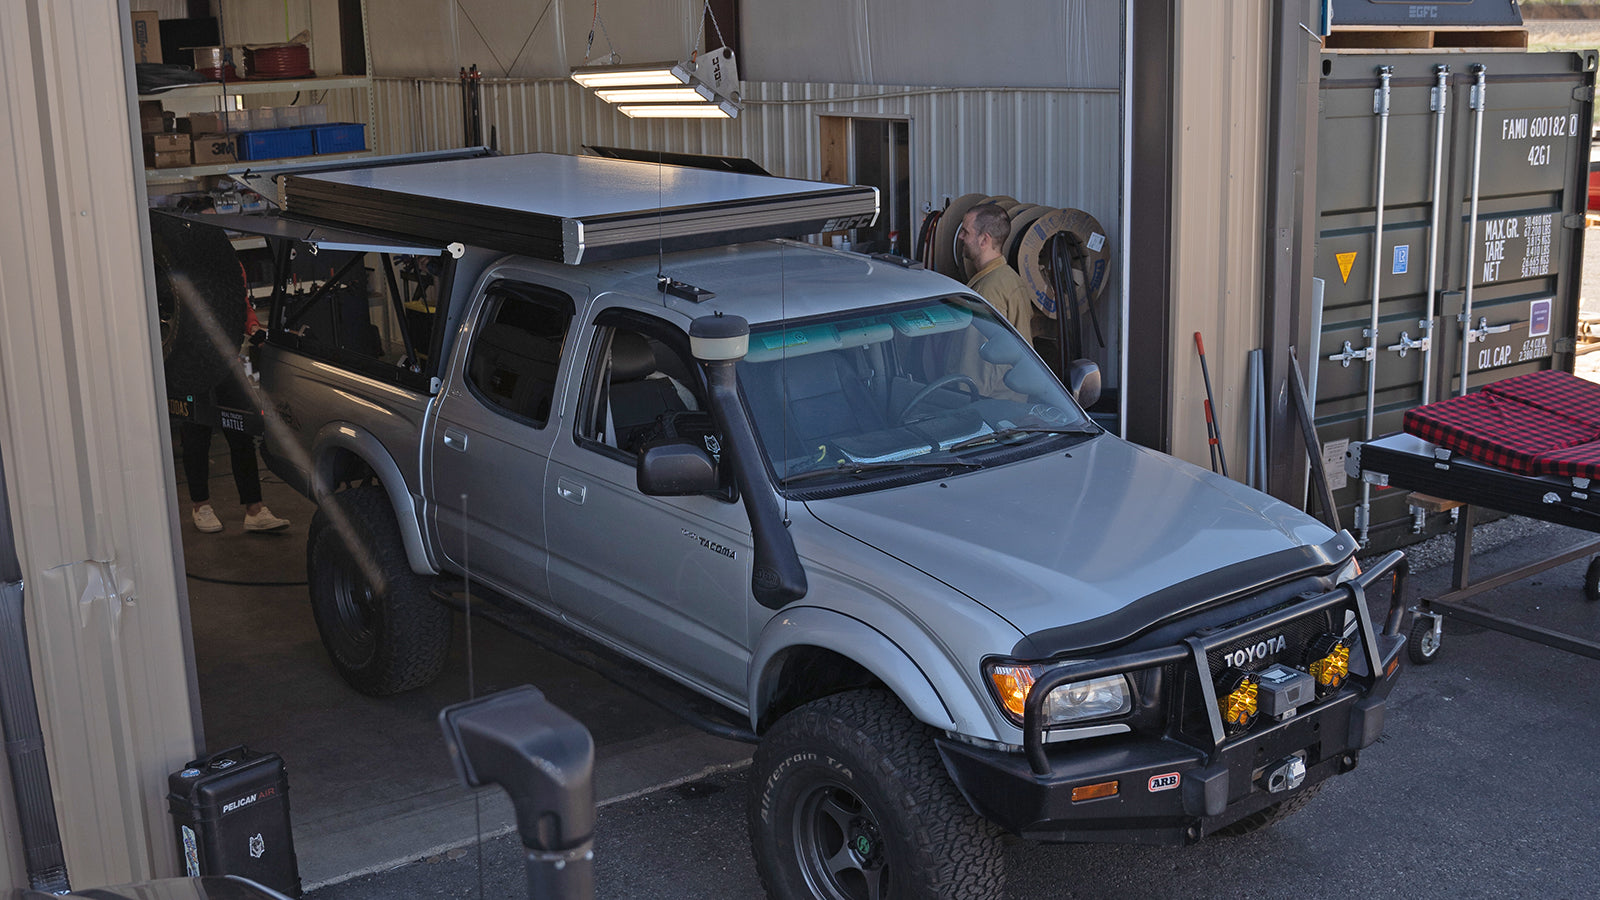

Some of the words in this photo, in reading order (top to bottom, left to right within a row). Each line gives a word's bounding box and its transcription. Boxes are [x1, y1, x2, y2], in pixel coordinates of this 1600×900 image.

[1502, 118, 1527, 140] FAMU
[1530, 115, 1566, 137] 600182
[1569, 115, 1577, 136] 0
[212, 141, 235, 155] 3M
[1527, 145, 1550, 166] 42G1
[1541, 225, 1551, 236] LBS
[1485, 240, 1506, 262] TARE
[1541, 244, 1550, 255] LBS
[1482, 261, 1501, 282] NET
[1539, 264, 1549, 275] LBS
[221, 417, 244, 432] RATTLE
[699, 537, 737, 561] TACOMA
[1224, 634, 1287, 668] TOYOTA
[1152, 775, 1177, 788] ARB
[223, 793, 257, 814] PELICAN
[258, 787, 275, 800] AIR
